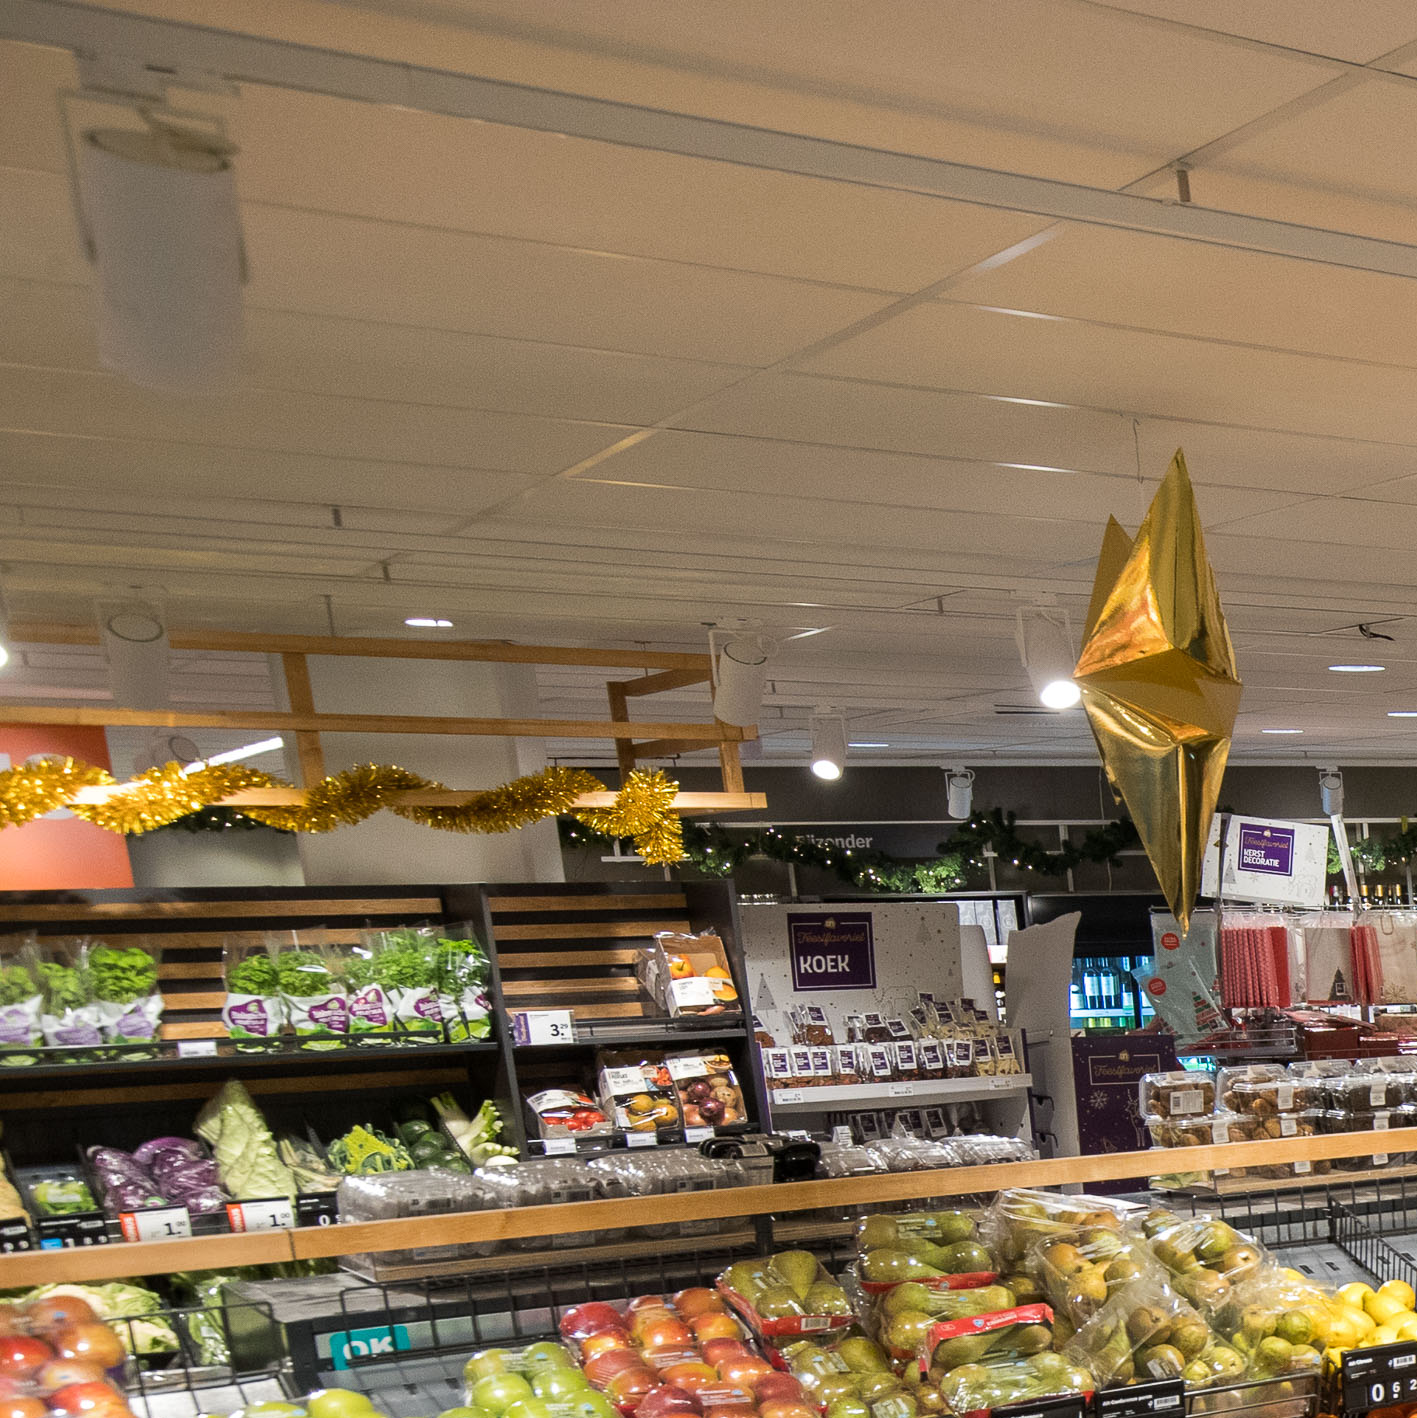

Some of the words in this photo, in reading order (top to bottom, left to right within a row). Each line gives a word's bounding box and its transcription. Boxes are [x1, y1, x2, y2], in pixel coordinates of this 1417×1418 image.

[1243, 848, 1265, 858] KERST
[1243, 856, 1280, 868] DECORATIE
[800, 955, 851, 974] KOEK
[343, 1335, 395, 1360] OK
